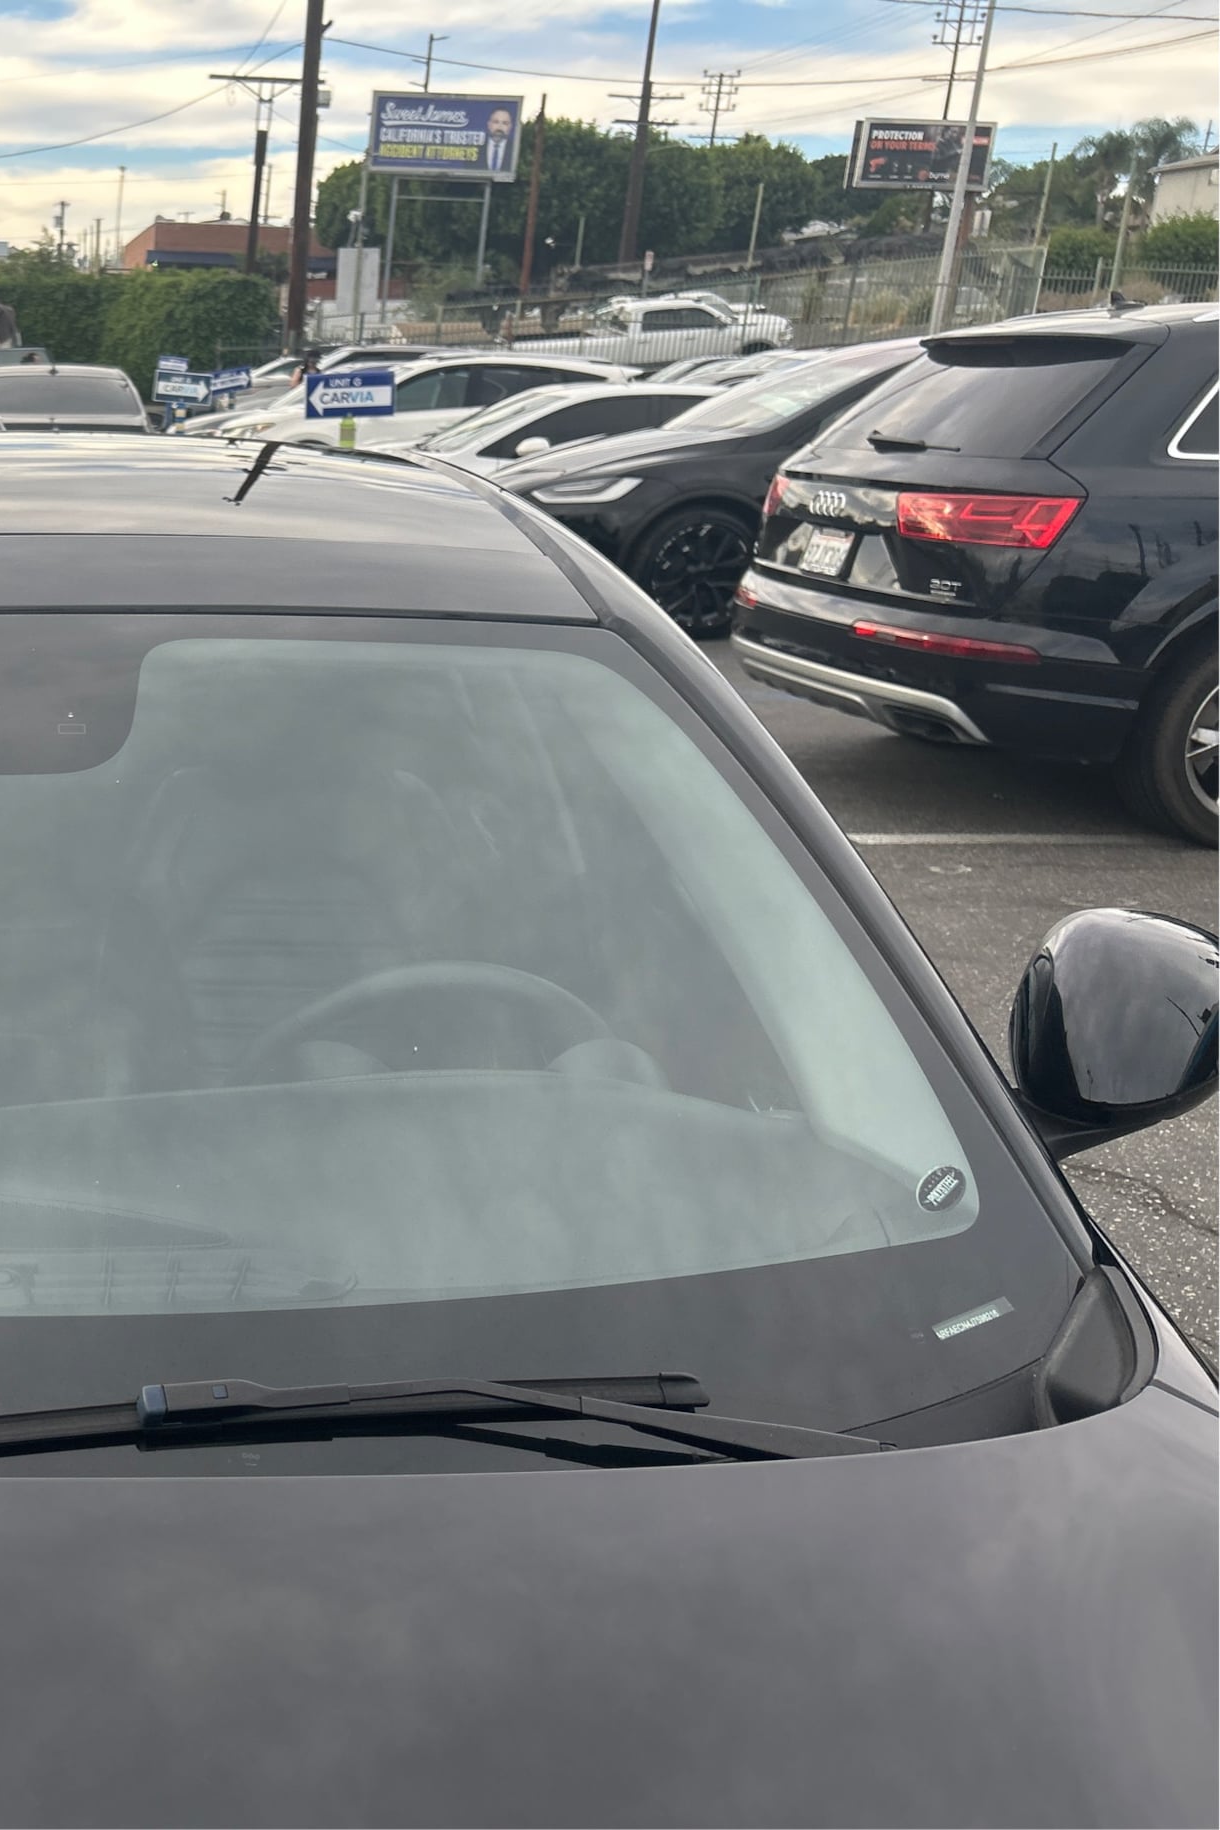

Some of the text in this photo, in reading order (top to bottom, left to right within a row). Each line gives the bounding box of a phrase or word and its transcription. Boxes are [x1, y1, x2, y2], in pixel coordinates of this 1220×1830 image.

[380, 102, 467, 123] Sweet James
[380, 128, 486, 146] CALIFORNIA'S TRUSTED
[872, 130, 924, 140] PROTECTION
[870, 140, 884, 150] ON
[884, 141, 908, 151] YOUR
[329, 377, 351, 387] UNIT
[320, 391, 374, 405] CARVIA
